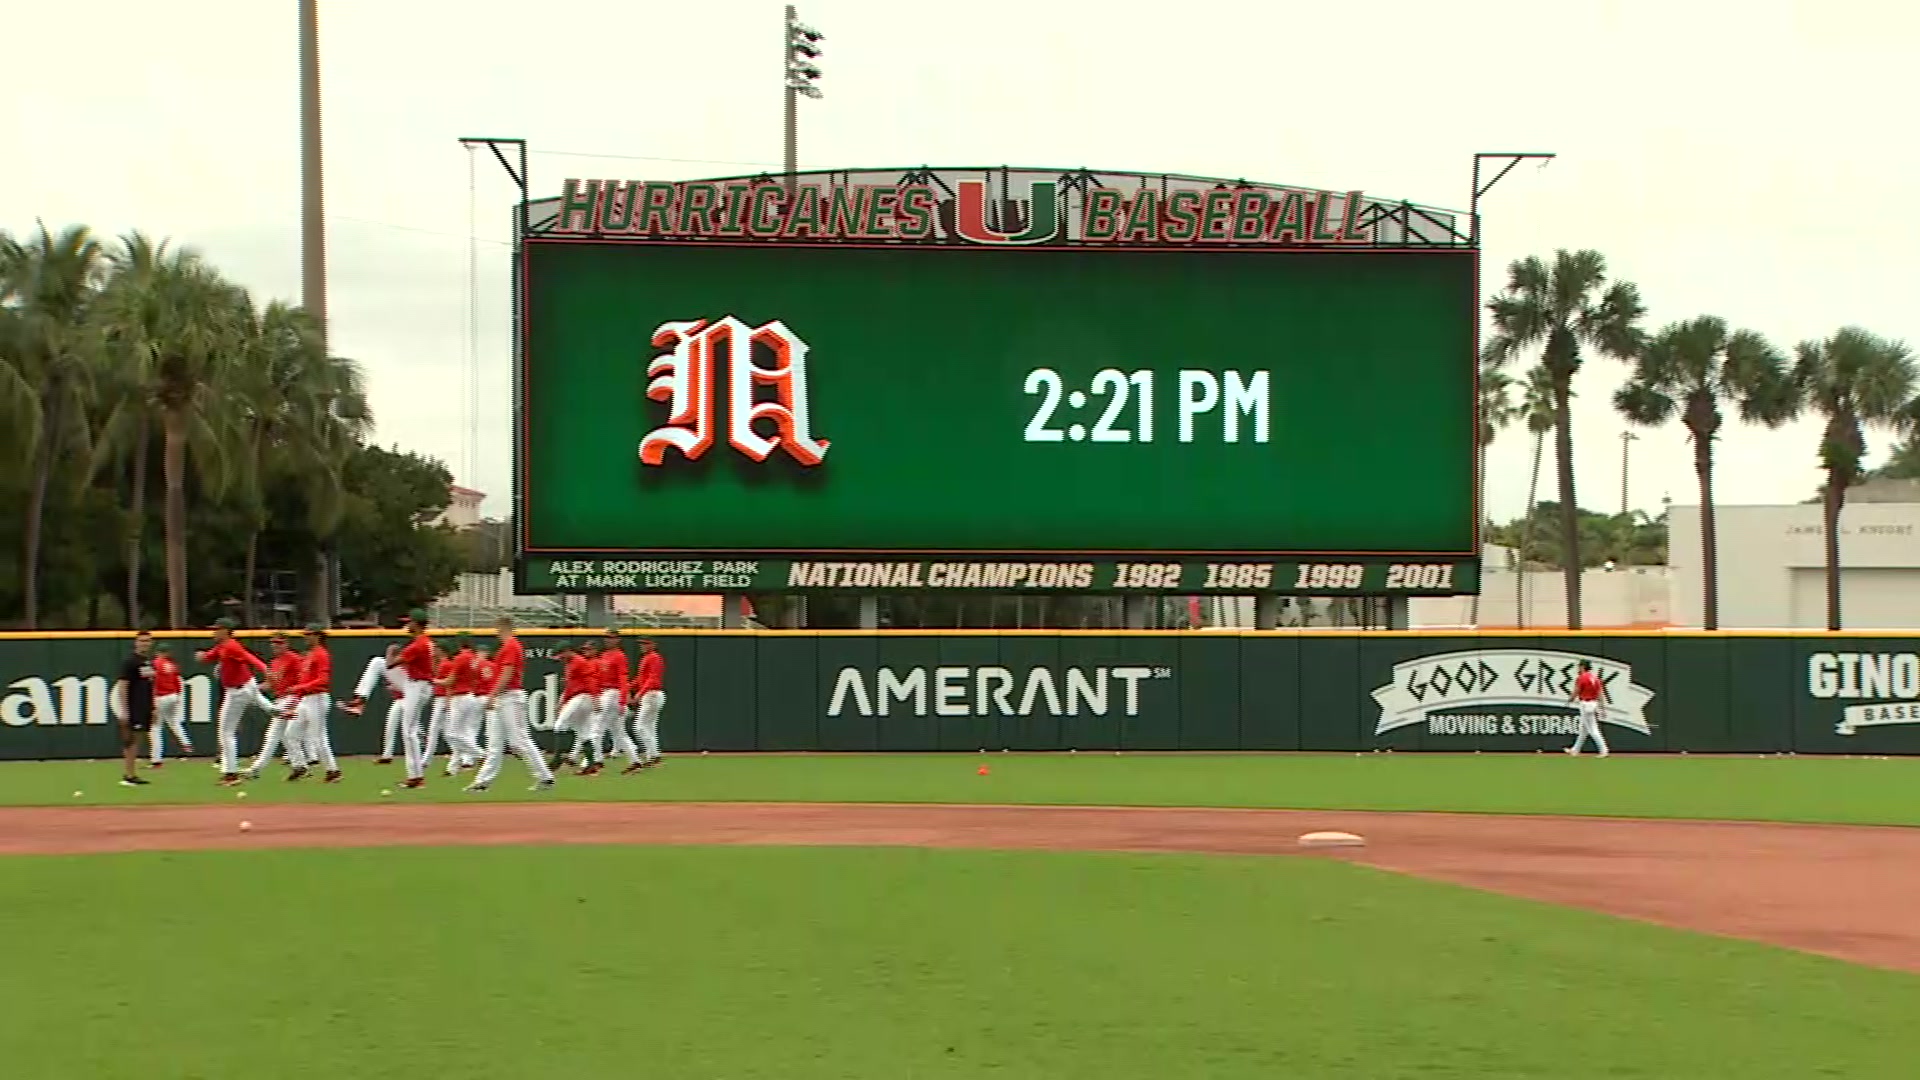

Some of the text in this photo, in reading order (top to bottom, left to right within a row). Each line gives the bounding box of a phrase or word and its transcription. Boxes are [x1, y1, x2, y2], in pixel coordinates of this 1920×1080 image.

[557, 178, 937, 238] HURRICANES
[955, 179, 1059, 246] U
[1083, 188, 1371, 243] BASEBALL
[1023, 368, 1271, 443] 2:21 PM
[550, 560, 760, 575] ALEX RODRIGUEZ PARK
[556, 574, 752, 589] AT MARK LIGHT FIELD
[787, 561, 1094, 589] NATIONAL CHAMPIONS
[1112, 562, 1182, 590] 1982
[1203, 562, 1273, 590] 1985
[1293, 562, 1364, 590] 1999
[1385, 562, 1455, 590] 2001
[826, 667, 1151, 717] AMERANT
[1406, 657, 1620, 705] GOOD GREK
[1429, 715, 1498, 735] MOVING
[1502, 715, 1516, 735] &
